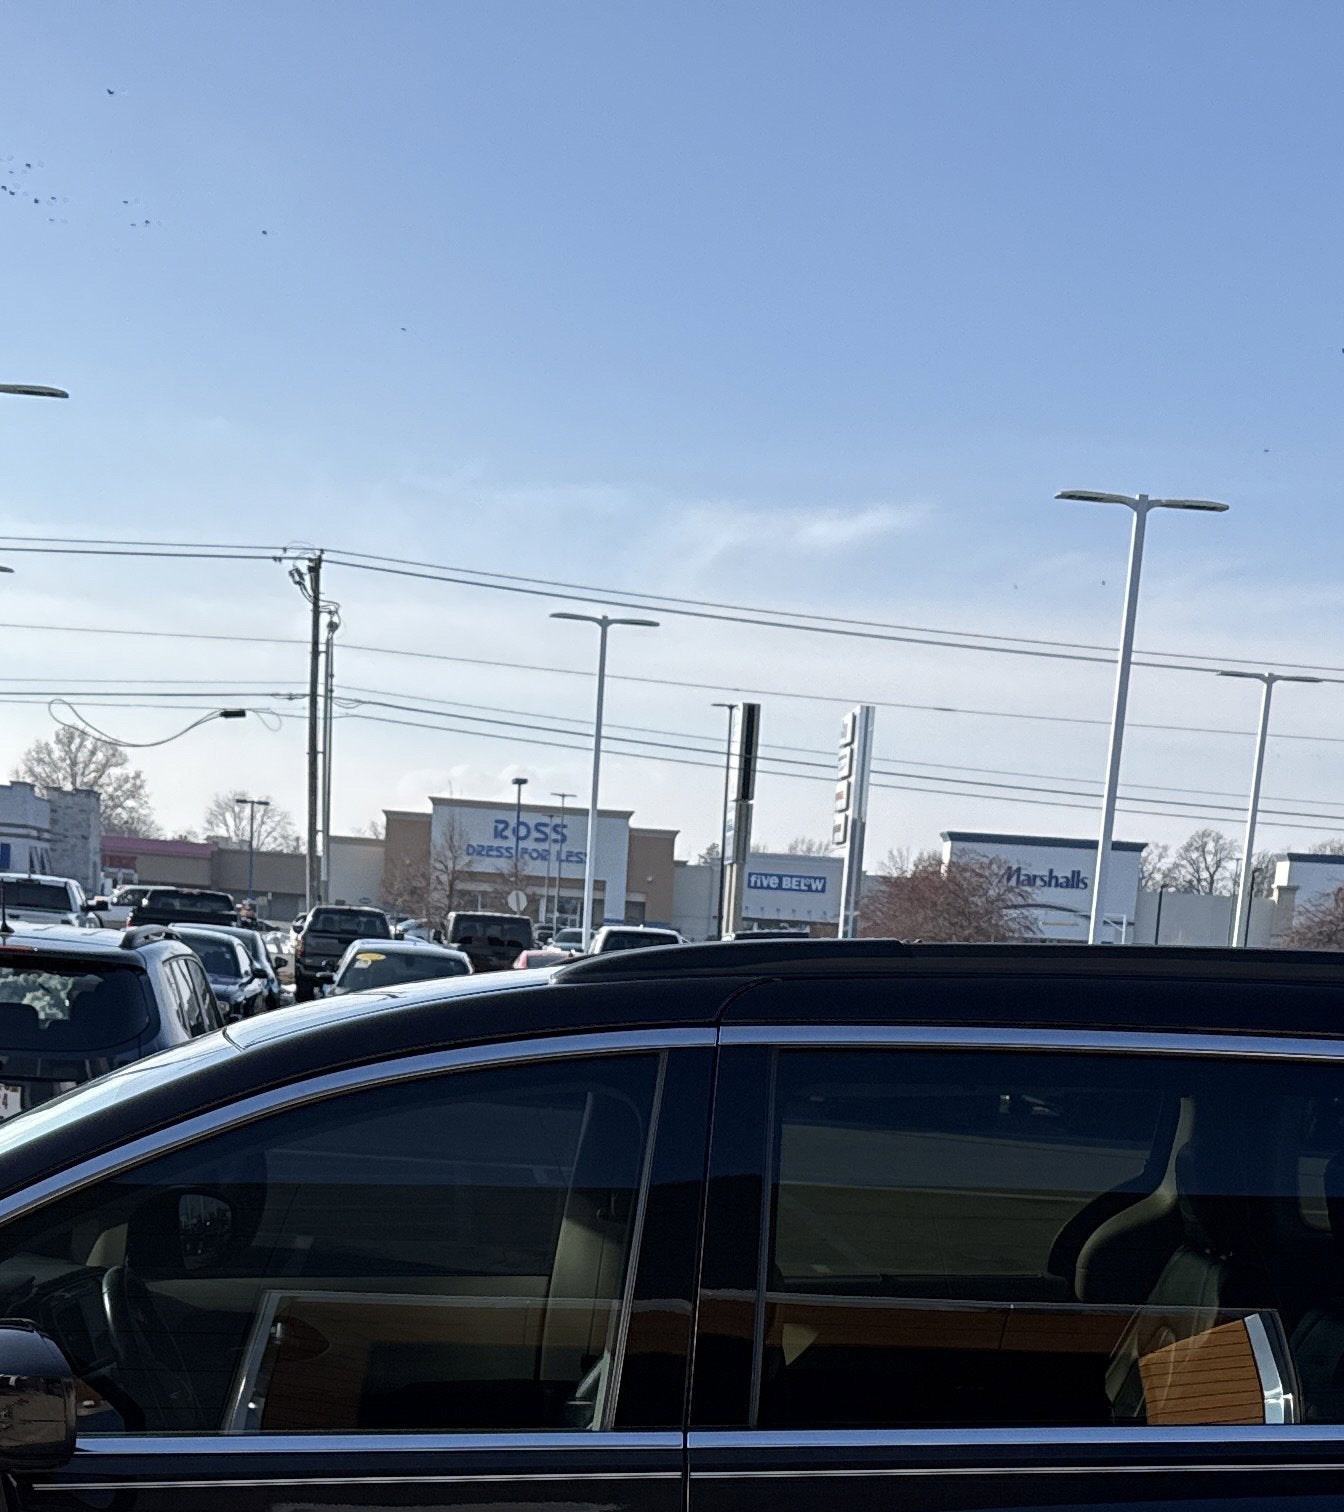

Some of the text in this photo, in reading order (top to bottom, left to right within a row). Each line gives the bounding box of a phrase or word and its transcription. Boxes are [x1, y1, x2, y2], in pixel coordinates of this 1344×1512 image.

[494, 819, 568, 844] ROSS
[465, 844, 514, 858] DRESS
[520, 847, 550, 860] FOR
[1001, 866, 1088, 889] Marshalls
